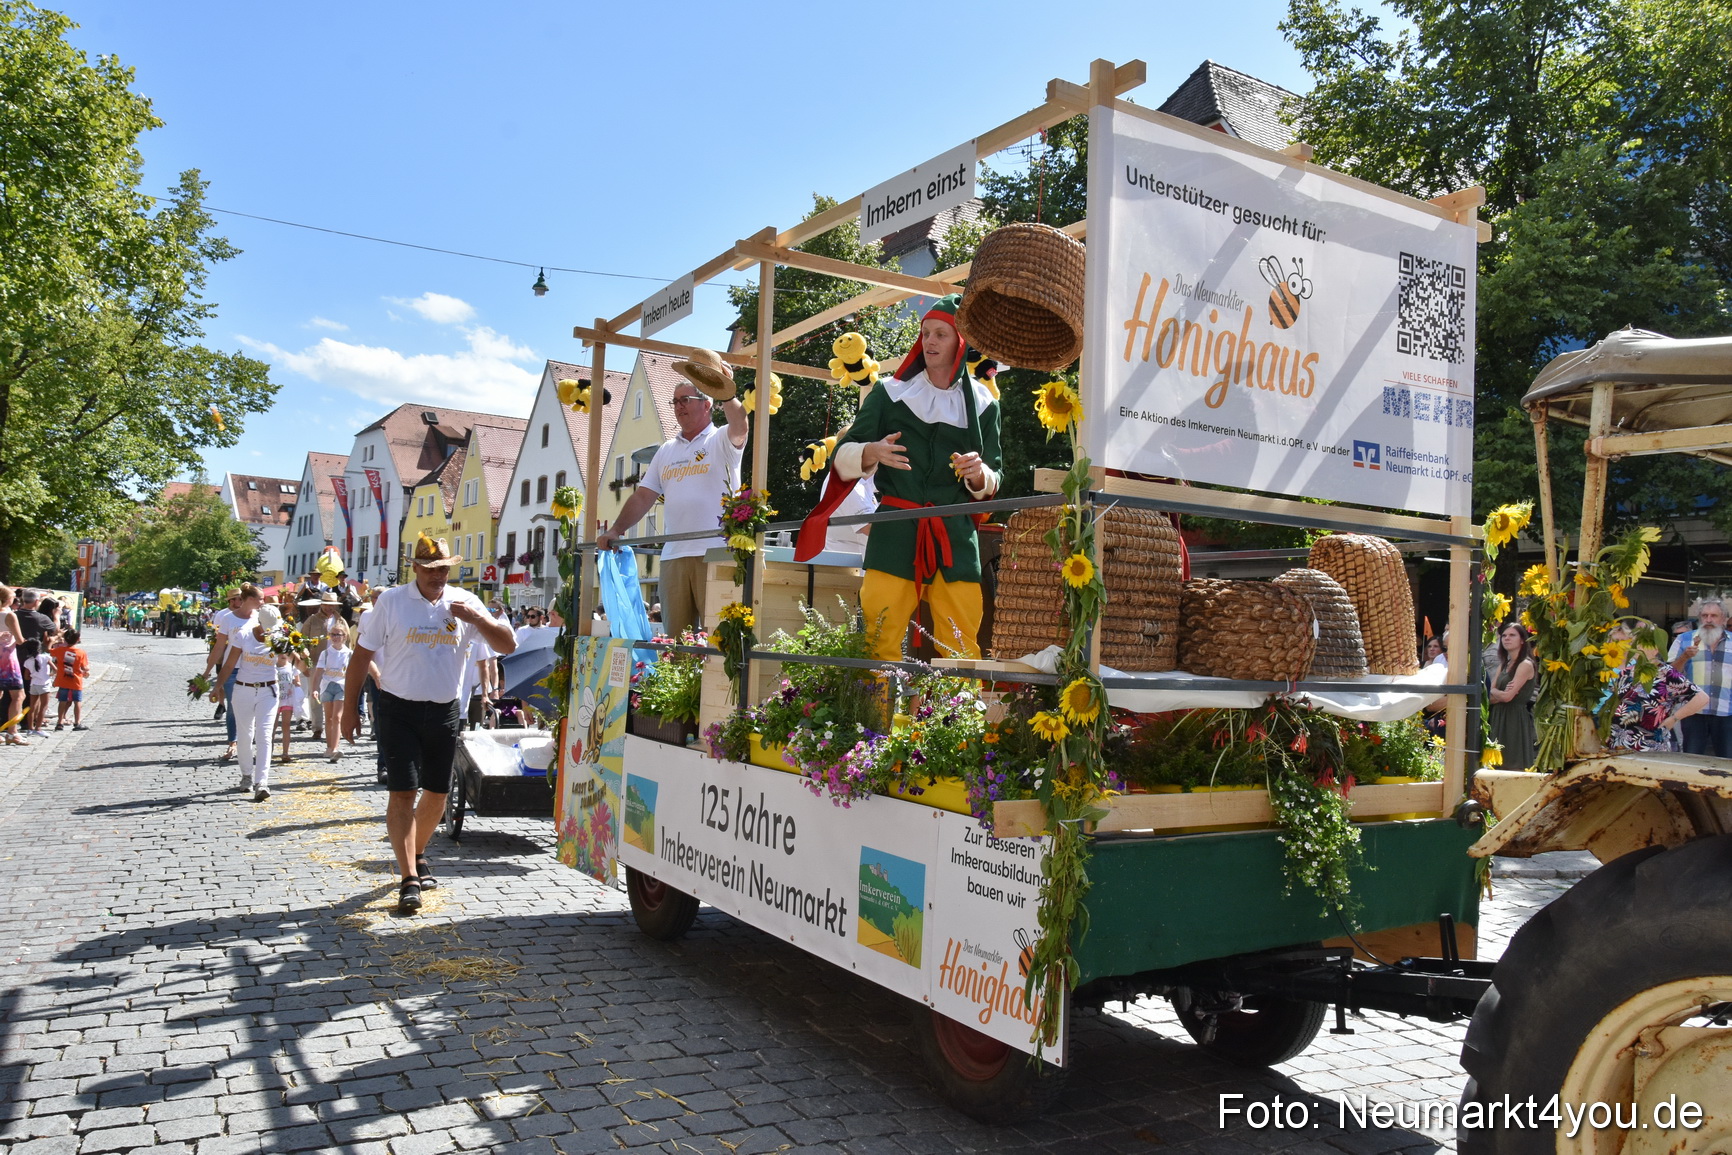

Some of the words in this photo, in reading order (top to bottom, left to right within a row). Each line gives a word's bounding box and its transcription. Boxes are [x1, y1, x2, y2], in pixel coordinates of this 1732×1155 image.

[867, 188, 922, 228] Imkern
[926, 163, 966, 201] einst
[1126, 164, 1230, 216] Unterstützer
[1232, 205, 1299, 236] gesucht
[1301, 220, 1327, 244] für:
[643, 303, 668, 329] Imkern
[668, 289, 690, 314] heute
[1173, 273, 1193, 299] Das
[1193, 280, 1245, 312] Neumarkter
[1123, 271, 1320, 409] Honighaus
[1402, 371, 1421, 382] VIELE
[1423, 375, 1459, 389] SCHAFFEN
[1382, 386, 1473, 429] MEHR
[1120, 406, 1139, 420] Eine
[1140, 411, 1169, 425] Aktion
[1170, 416, 1186, 428] des
[1188, 419, 1236, 437] Imkerverein
[1237, 428, 1275, 445] Neumarkt
[1321, 444, 1336, 454] und
[1337, 446, 1351, 457] der
[1385, 445, 1450, 466] Raiffeisenbank
[1385, 460, 1429, 478] Neumarkt
[1462, 472, 1473, 484] eG
[700, 782, 730, 832] 125
[734, 787, 796, 855] Jahre
[964, 826, 983, 846] Zur
[986, 833, 1035, 860] besseren
[661, 826, 745, 896] Imkerverein
[750, 860, 847, 938] Neumarkt
[859, 879, 901, 905] Imkerverein
[967, 876, 1004, 903] bauen
[1007, 892, 1027, 909] wir
[963, 938, 974, 955] Das
[974, 943, 1003, 965] Neumarkter
[939, 937, 1045, 1026] Honighau
